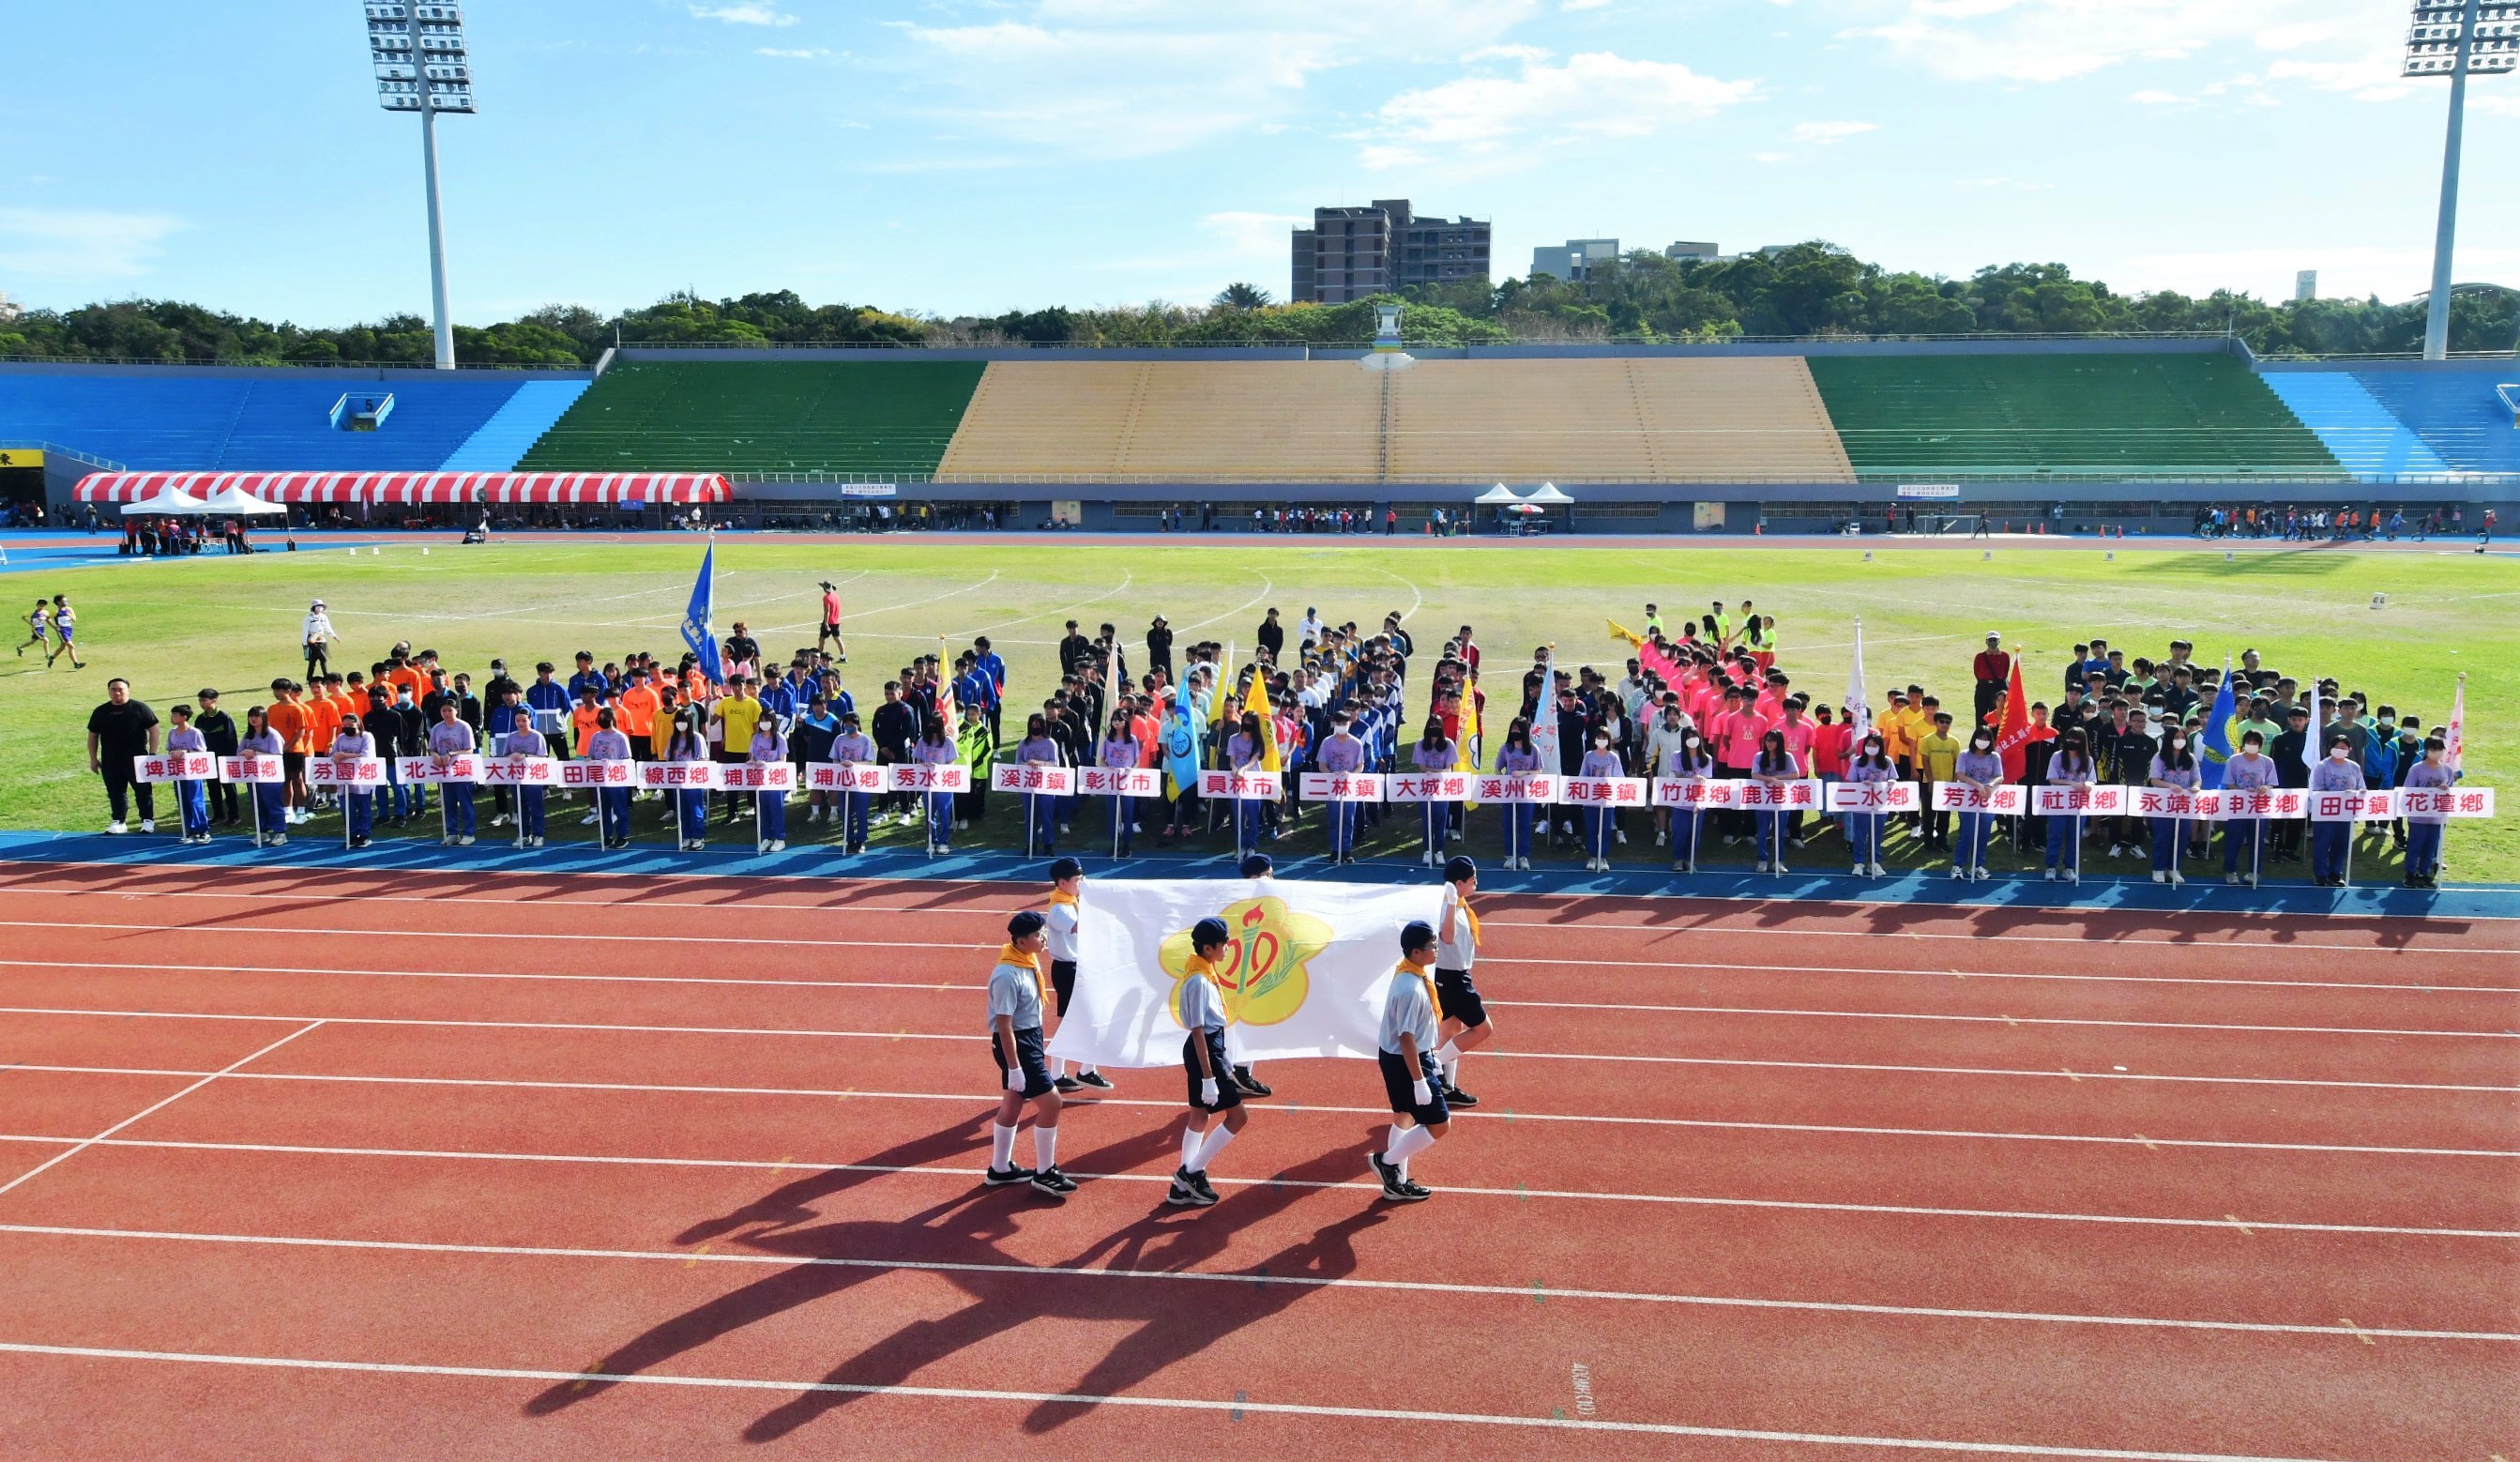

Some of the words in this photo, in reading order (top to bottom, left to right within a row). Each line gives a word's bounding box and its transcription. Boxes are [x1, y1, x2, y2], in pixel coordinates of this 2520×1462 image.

[144, 756, 208, 777] 埤頭鄉
[225, 758, 278, 779] 福興鄉
[314, 762, 378, 781] 芬園鄉
[485, 762, 548, 781] 大村鄉
[565, 766, 627, 784] 田尾鄉
[645, 766, 708, 784] 線西鄉
[724, 767, 788, 786] 埔鹽鄉
[814, 768, 878, 788] 埔心鄉
[896, 768, 961, 788] 秀水鄉
[1000, 768, 1066, 790] 溪湖鎮
[1085, 770, 1150, 792] 彰化市
[1207, 775, 1272, 795] 員林市
[1308, 777, 1376, 797] 二林鎮
[1396, 778, 1465, 798] 大城鄉
[1481, 779, 1549, 799] 溪州鄉
[1568, 782, 1637, 801] 和美鎮
[1661, 783, 1731, 804] 竹塘鄉
[1741, 783, 1812, 804] 鹿港鎮
[1836, 785, 1909, 807] 二水鄉
[1943, 787, 2015, 808] 芳苑鄉
[2042, 790, 2118, 810] 社頭鄉
[2139, 793, 2220, 815] 永靖鄉
[2320, 796, 2388, 816] 田中鎮
[2406, 792, 2483, 813] 花壇鄉
